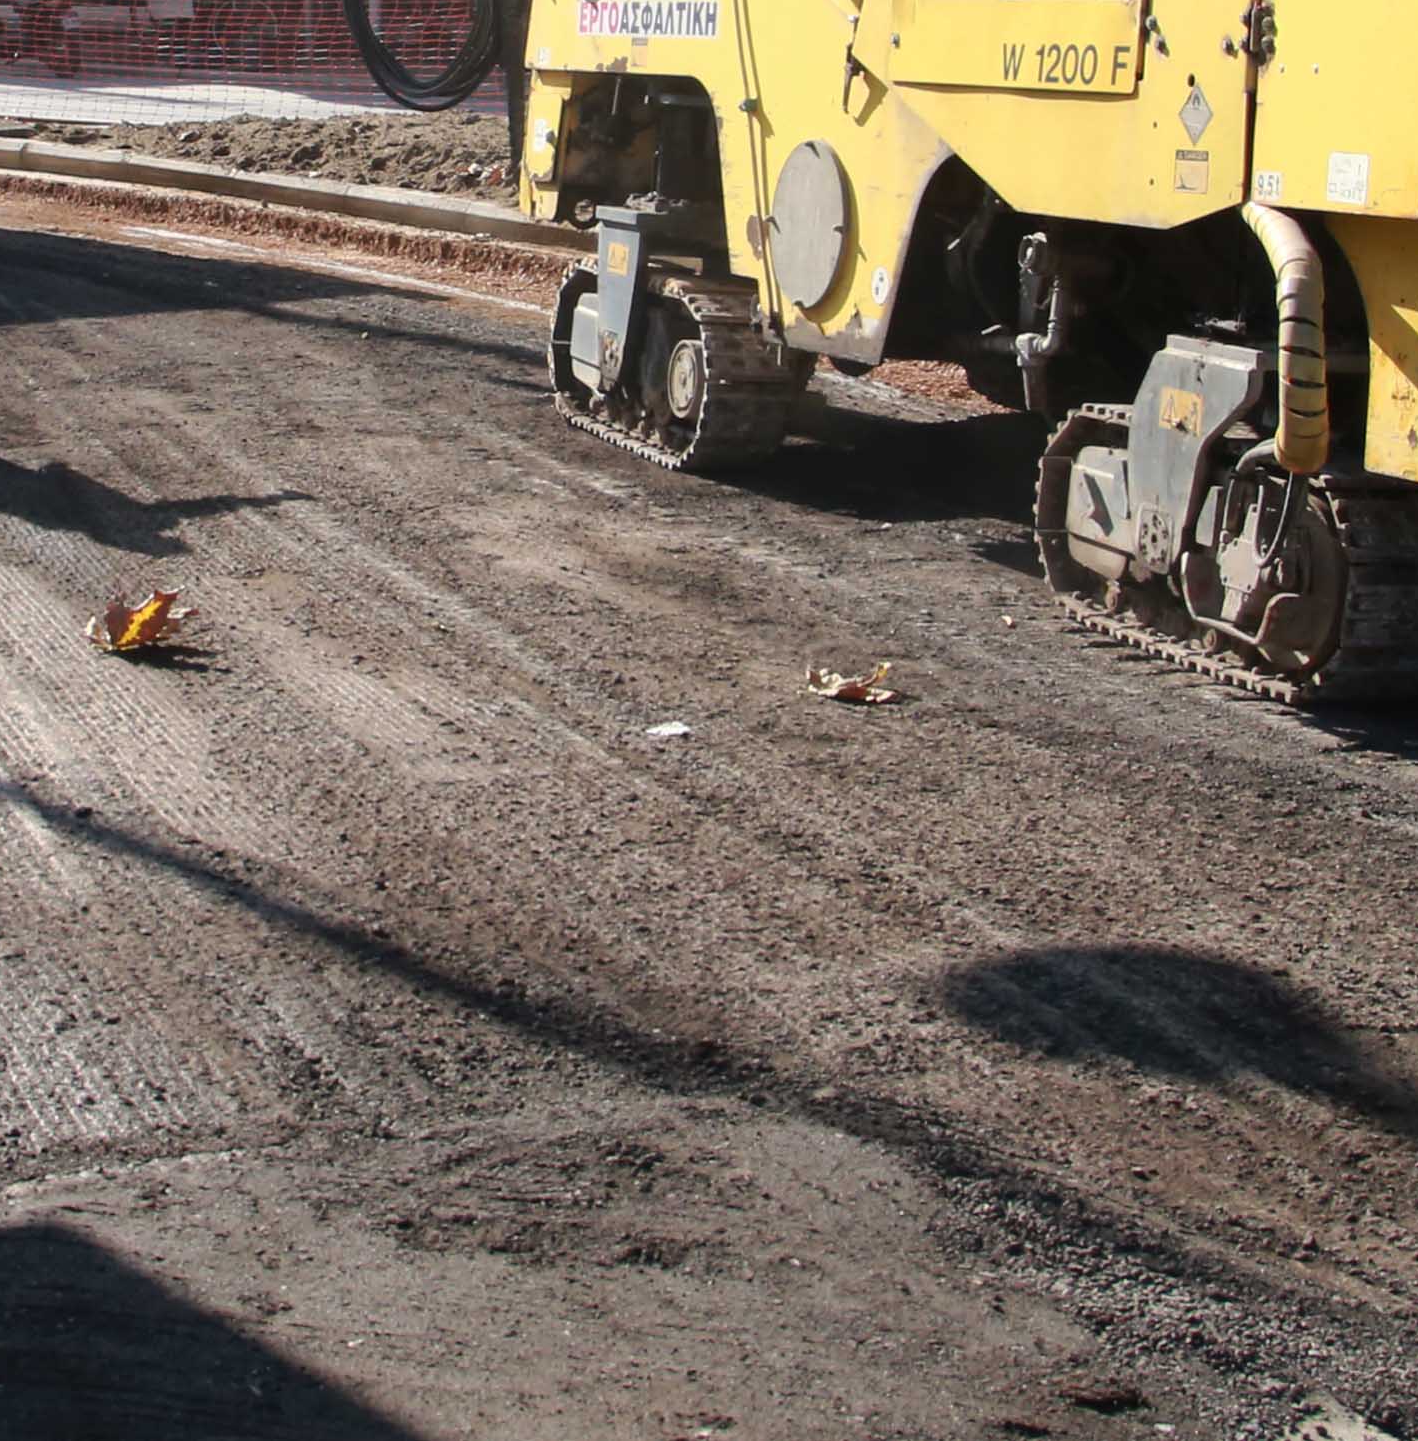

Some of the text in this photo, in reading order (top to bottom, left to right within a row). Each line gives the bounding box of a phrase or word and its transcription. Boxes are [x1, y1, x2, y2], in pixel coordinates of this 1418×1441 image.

[579, 1, 718, 36] ΕΡΓΟΑΣΦΑΛΤΙΚΗ
[1003, 43, 1130, 85] W 1200 F
